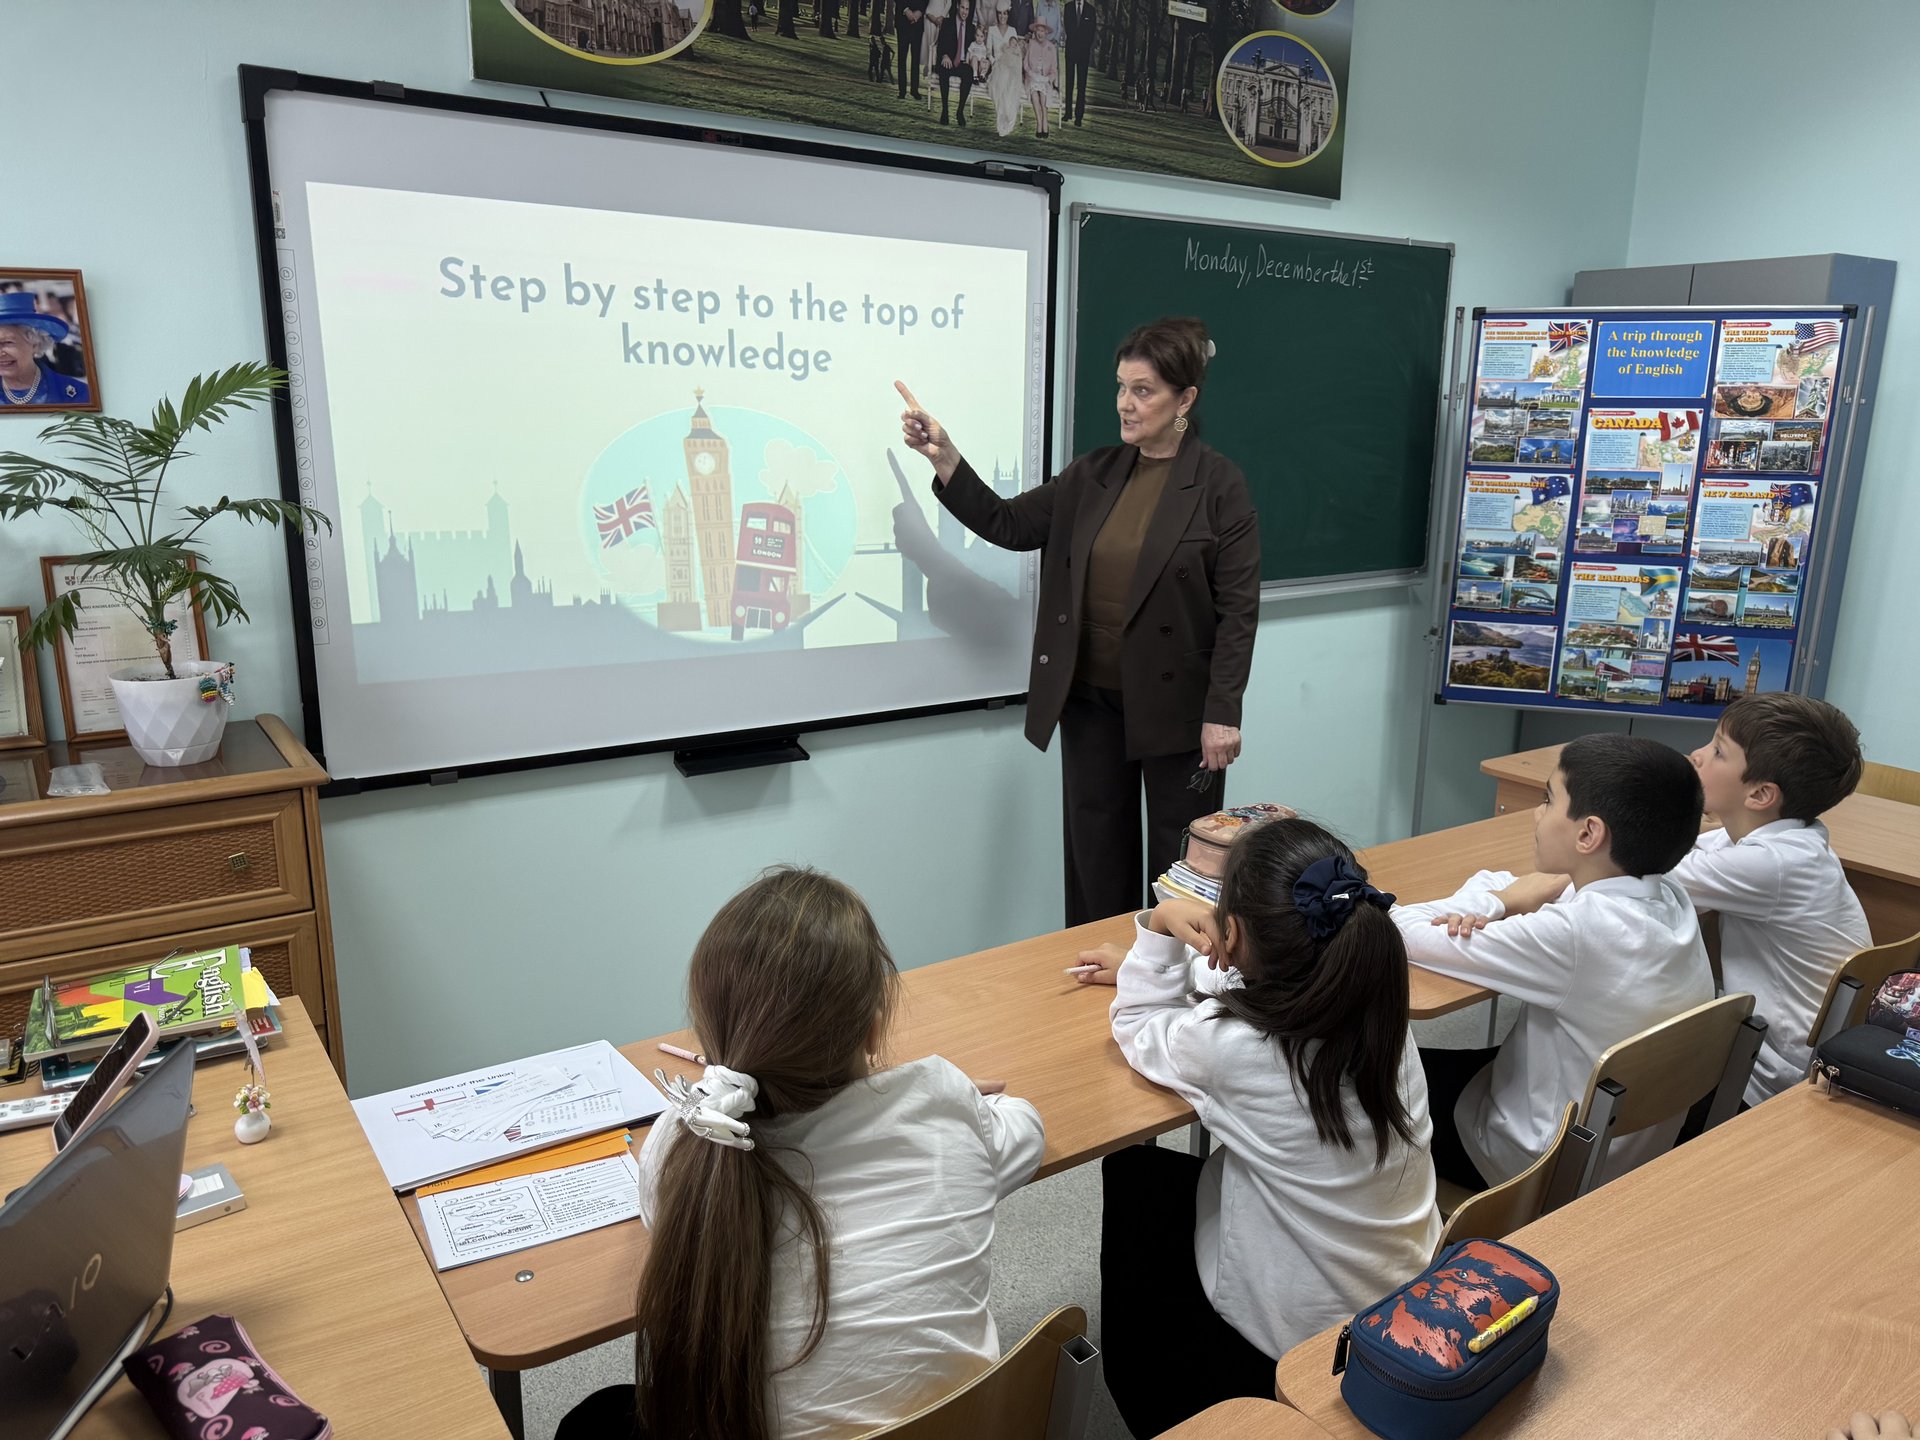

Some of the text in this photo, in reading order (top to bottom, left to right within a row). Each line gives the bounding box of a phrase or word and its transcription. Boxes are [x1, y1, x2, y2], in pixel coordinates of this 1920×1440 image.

[1184, 237, 1251, 288] Monday,
[1256, 244, 1328, 283] December
[439, 256, 965, 335] Step by step to the top of
[1608, 330, 1703, 344] A trip through
[621, 322, 833, 381] knowledge
[1607, 346, 1700, 360] the knowledge
[1618, 363, 1683, 377] of English
[1591, 417, 1662, 429] CANADA
[1729, 491, 1777, 499] ZEALAND
[752, 549, 782, 559] LONDON
[1574, 573, 1650, 584] THE BAHAMAS
[410, 1085, 455, 1099] Evolution
[487, 1071, 515, 1081] Union
